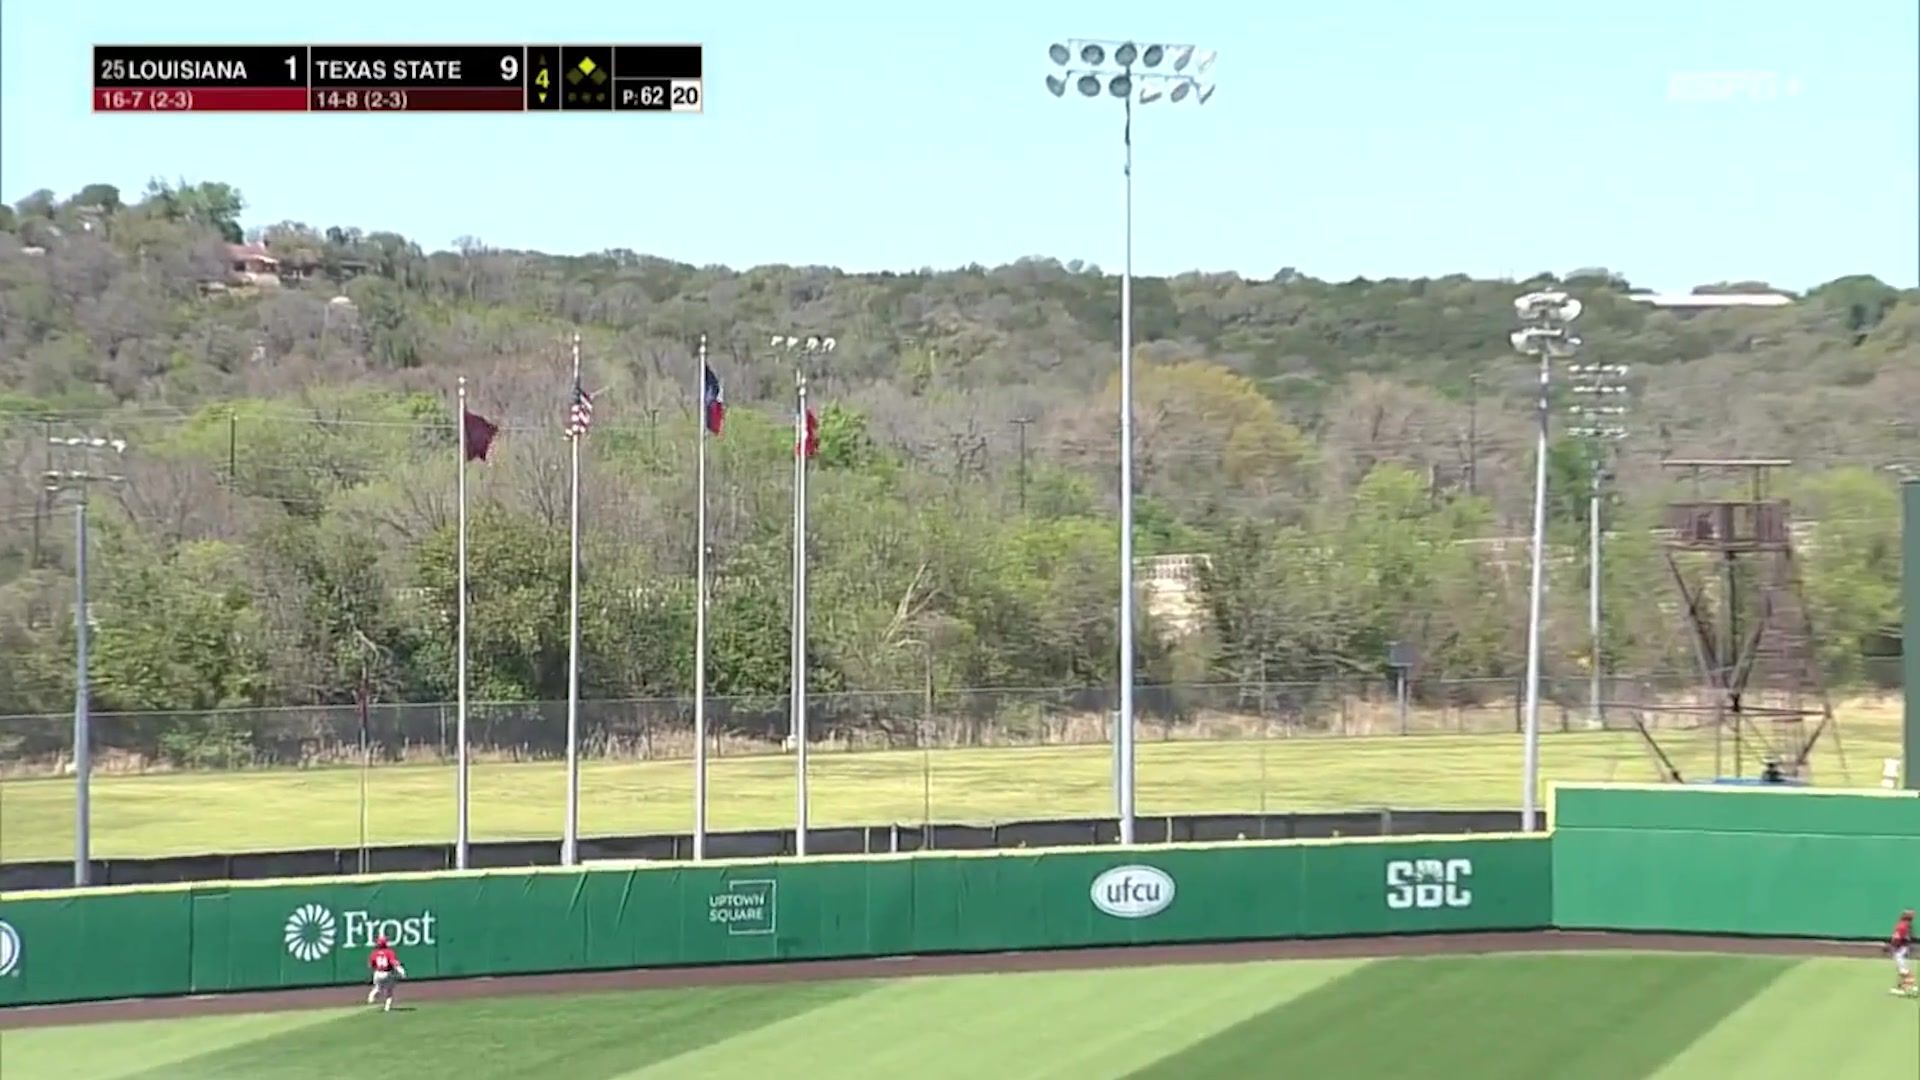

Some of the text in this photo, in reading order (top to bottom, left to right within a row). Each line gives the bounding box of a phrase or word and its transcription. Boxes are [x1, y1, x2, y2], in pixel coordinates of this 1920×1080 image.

[1107, 876, 1160, 903] ufcu
[1386, 858, 1473, 909] SBC
[709, 893, 765, 907] UPTOWN
[342, 909, 436, 948] Frost
[709, 907, 764, 923] SQUARE
